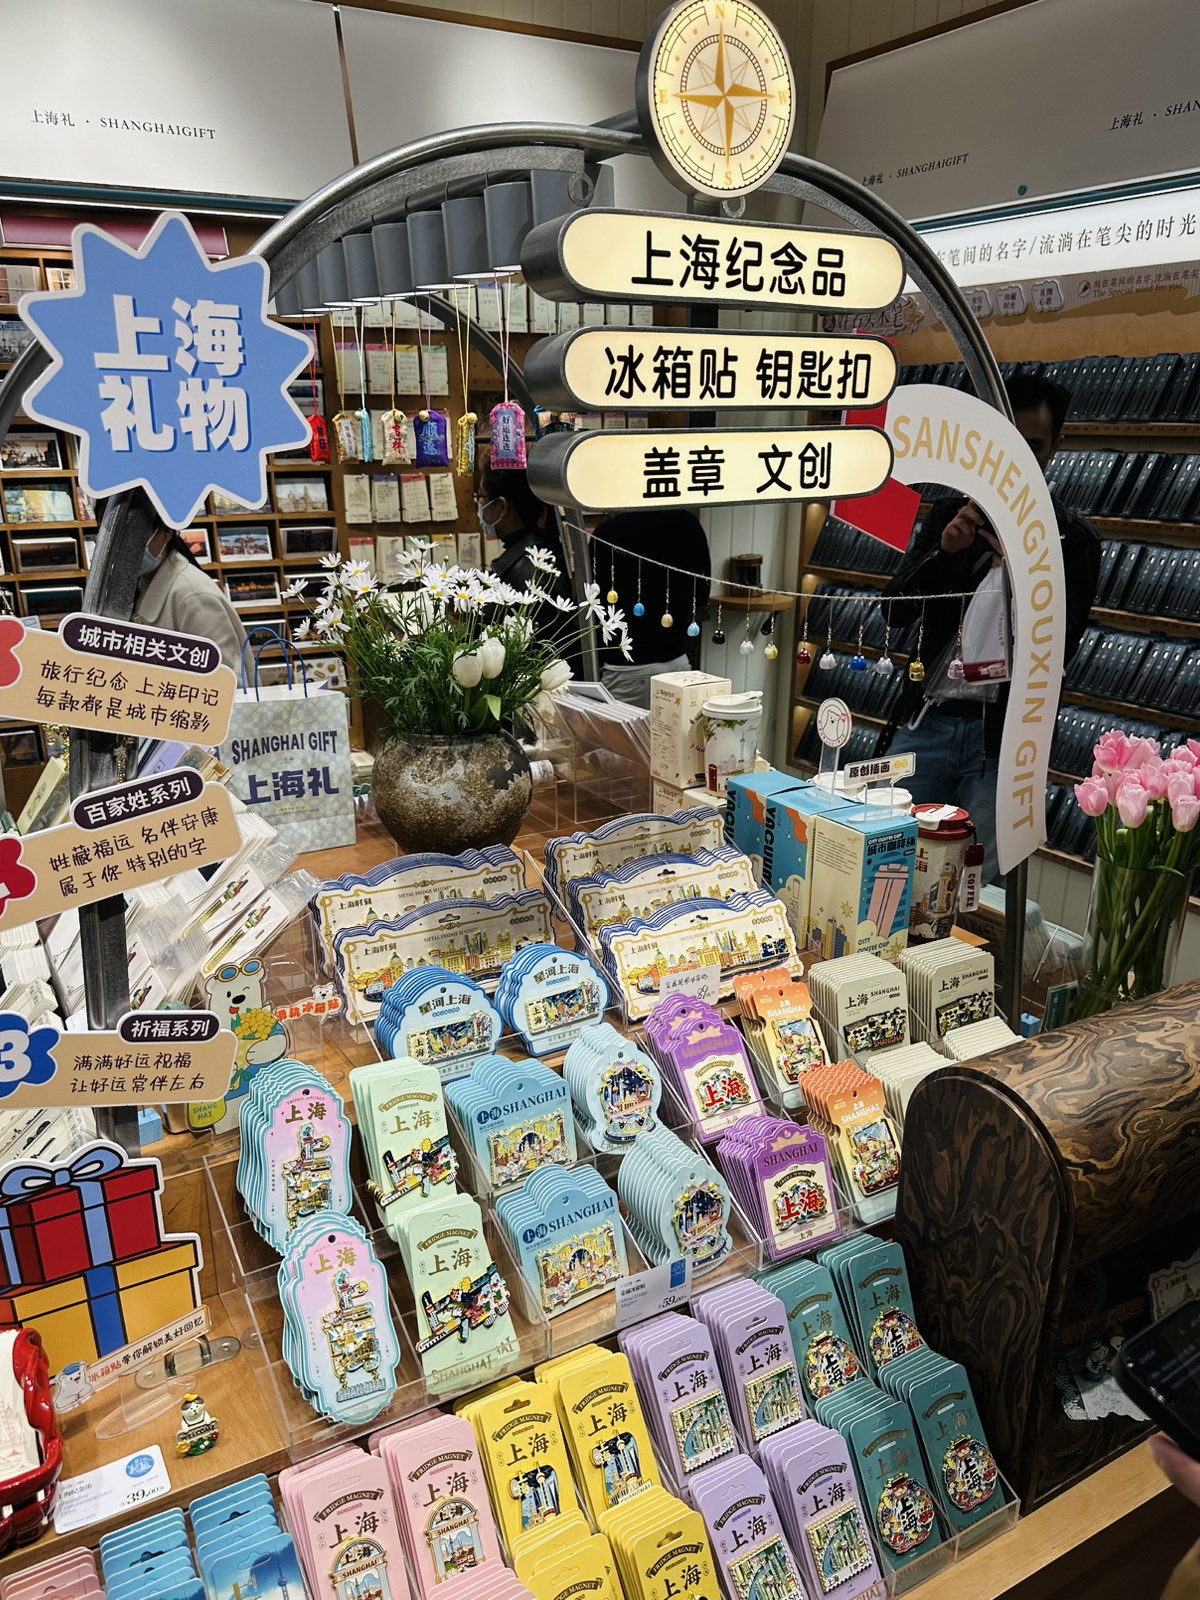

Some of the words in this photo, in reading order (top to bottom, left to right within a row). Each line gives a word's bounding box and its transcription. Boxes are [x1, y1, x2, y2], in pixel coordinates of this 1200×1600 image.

[715, 4, 725, 19] N
[659, 89, 669, 104] E
[777, 90, 789, 106] W
[31, 109, 75, 128] 上海礼
[100, 116, 216, 140] SHANGHAIGIFT
[1108, 111, 1144, 131] 上海礼
[724, 172, 733, 186] S
[861, 172, 884, 187] 上海礼
[896, 153, 970, 179] SHANGHAIGIFT
[631, 230, 846, 297] 上海纪念品
[94, 294, 244, 377] 上海
[605, 344, 738, 400] 冰箱贴
[756, 348, 872, 400] 钥匙扣
[99, 375, 250, 451] 礼物
[643, 445, 725, 498] 盖章
[756, 442, 833, 493] 文创
[893, 415, 1053, 723] SANSHENGYOUXIN
[1012, 740, 1038, 831] GIFT
[77, 624, 211, 669] 城市相关文创
[40, 659, 130, 691] 旅行纪念
[135, 677, 219, 707] 上海印记
[36, 685, 211, 733] 每款都是城市缩影
[231, 732, 304, 765] SHANGHAI
[308, 730, 338, 753] GIFT
[848, 761, 891, 779] 原创插画
[241, 766, 340, 805] 上海礼
[83, 776, 193, 824] 百家姓系列
[49, 833, 135, 872] 姓藏福运
[141, 806, 219, 844] 名伴安康
[762, 806, 777, 886] VACUUM
[58, 864, 124, 897] 属于你
[126, 837, 208, 872] 特别的字
[916, 847, 929, 873] 上海
[965, 873, 976, 908] COFFEE
[857, 937, 871, 946] CITY
[533, 963, 579, 984] 星河上海
[938, 976, 960, 993] 上海
[962, 967, 989, 980] SHANGHAI
[418, 993, 472, 1016] 星河上海
[844, 993, 869, 1010] 上海
[870, 985, 900, 998] SHANGHAI
[767, 1006, 807, 1018] SHANGHAI
[130, 1018, 210, 1037] 祈福系列
[73, 1051, 193, 1071] 满满好运祝福
[70, 1073, 205, 1093] 让好运常伴左右
[705, 1077, 742, 1108] 上海
[192, 1102, 218, 1114] SHANG
[197, 1111, 213, 1120] HAI
[285, 1101, 327, 1124] 上海
[385, 1097, 405, 1112] FRIDGE
[405, 1093, 430, 1103] MAGNET
[502, 1086, 567, 1117] SHANGHAI
[840, 1103, 881, 1124] SHANGHAI
[389, 1109, 434, 1136] 上海
[763, 1142, 819, 1167] SHANGHAI
[549, 1196, 614, 1233] SHANGHAI
[781, 1189, 820, 1221] 上海
[425, 1231, 447, 1247] FRIDGE
[447, 1230, 471, 1239] MAGNET
[314, 1246, 357, 1275] 上海
[428, 1247, 473, 1276] 上海
[869, 1284, 901, 1311] 上海
[800, 1310, 833, 1342] 上海
[890, 1327, 906, 1358] 上海
[747, 1343, 783, 1376] 上海
[825, 1353, 843, 1386] 上海
[335, 1378, 386, 1402] SHANGHAI
[578, 1390, 599, 1410] FRIDGE
[599, 1385, 623, 1396] MAGNET
[671, 1368, 709, 1403] 上海
[180, 1424, 216, 1441] WELCOME
[498, 1420, 519, 1440] FRIDGE
[519, 1414, 545, 1424] MAGNET
[587, 1402, 629, 1437] 上海
[506, 1432, 550, 1467] 上海
[721, 1440, 732, 1451] SH
[416, 1458, 438, 1477] FRIDGE
[438, 1453, 465, 1464] MAGNET
[818, 1466, 842, 1478] MAGNET
[964, 1458, 982, 1490] 上海
[422, 1471, 470, 1508] 上海
[809, 1482, 846, 1517] 上海
[321, 1498, 346, 1517] FRIDGE
[346, 1491, 375, 1503] MAGNET
[736, 1498, 759, 1511] MAGNET
[899, 1498, 918, 1533] 上海
[329, 1510, 380, 1549] 上海
[437, 1518, 470, 1537] SHANGHAI
[730, 1514, 768, 1554] 上海
[342, 1560, 378, 1579] SHANGHAI
[652, 1554, 672, 1573] FRIDGE
[672, 1545, 697, 1557] MAGNET
[859, 1558, 870, 1567] SH
[570, 1581, 596, 1593] MAGNET
[661, 1564, 702, 1600] 上海
